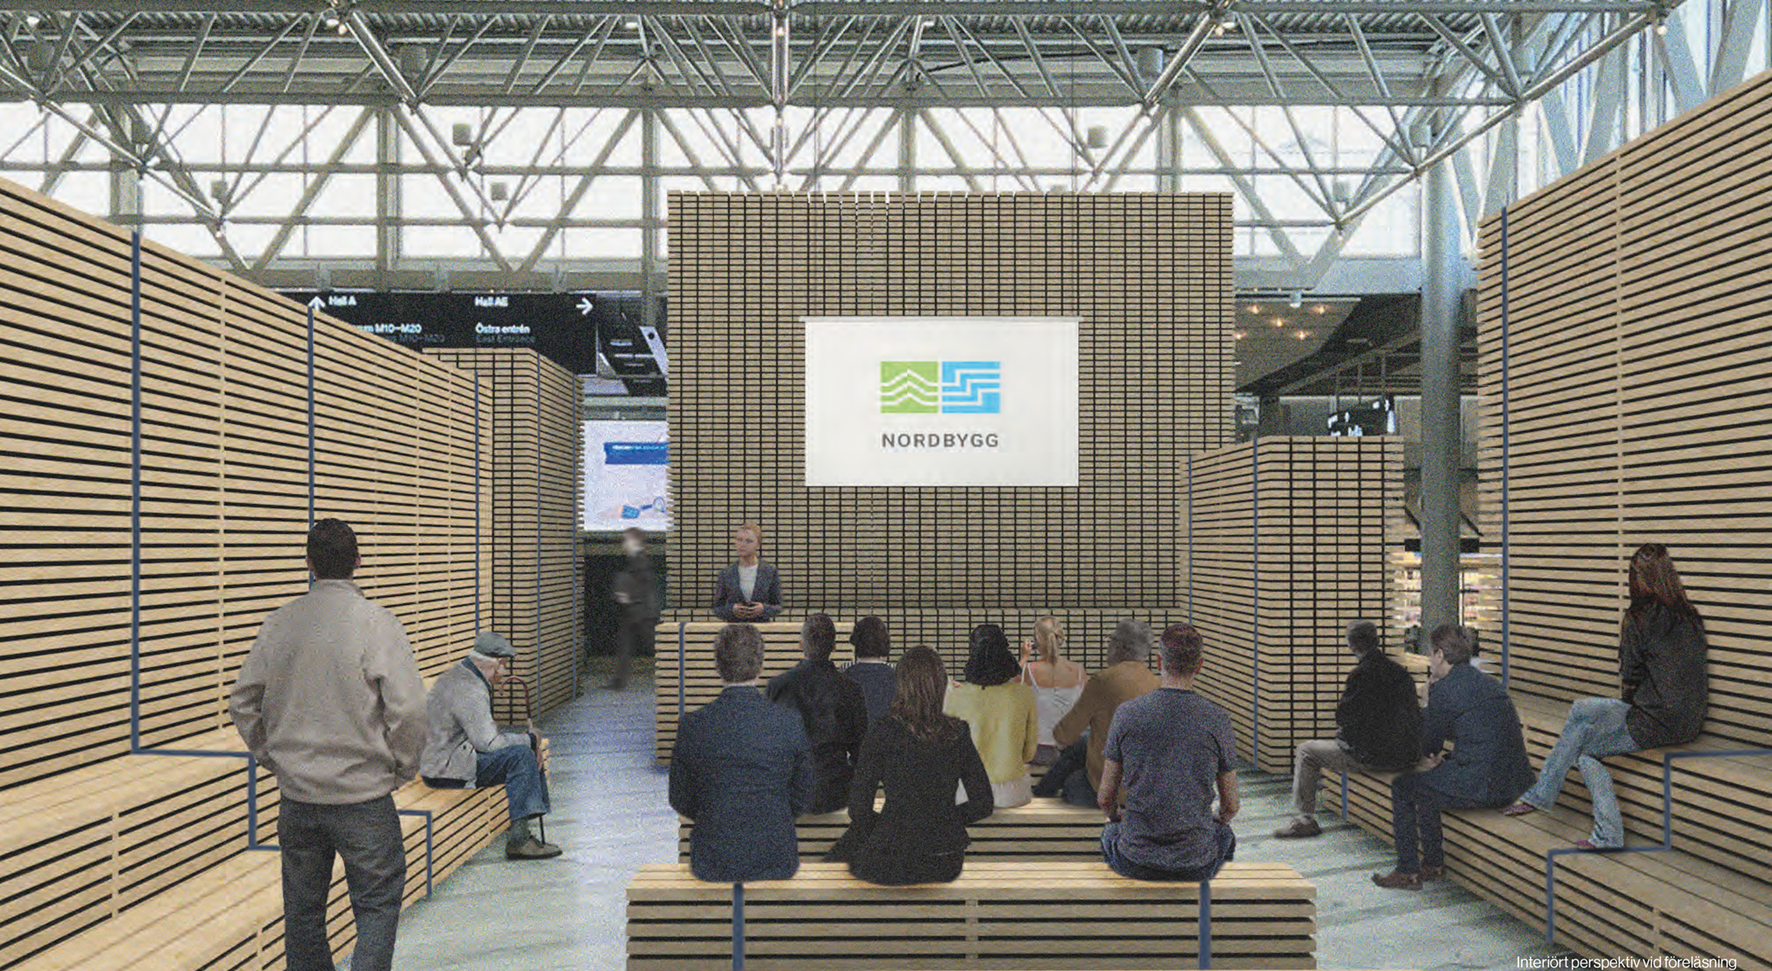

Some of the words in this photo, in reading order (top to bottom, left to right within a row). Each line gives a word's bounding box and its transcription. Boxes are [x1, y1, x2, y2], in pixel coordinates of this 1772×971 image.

[328, 295, 347, 306] Hall
[348, 295, 357, 306] A
[474, 296, 494, 307] Hall
[475, 322, 500, 334] Östra
[501, 323, 531, 334] entrén
[881, 433, 999, 448] NORDBYGG
